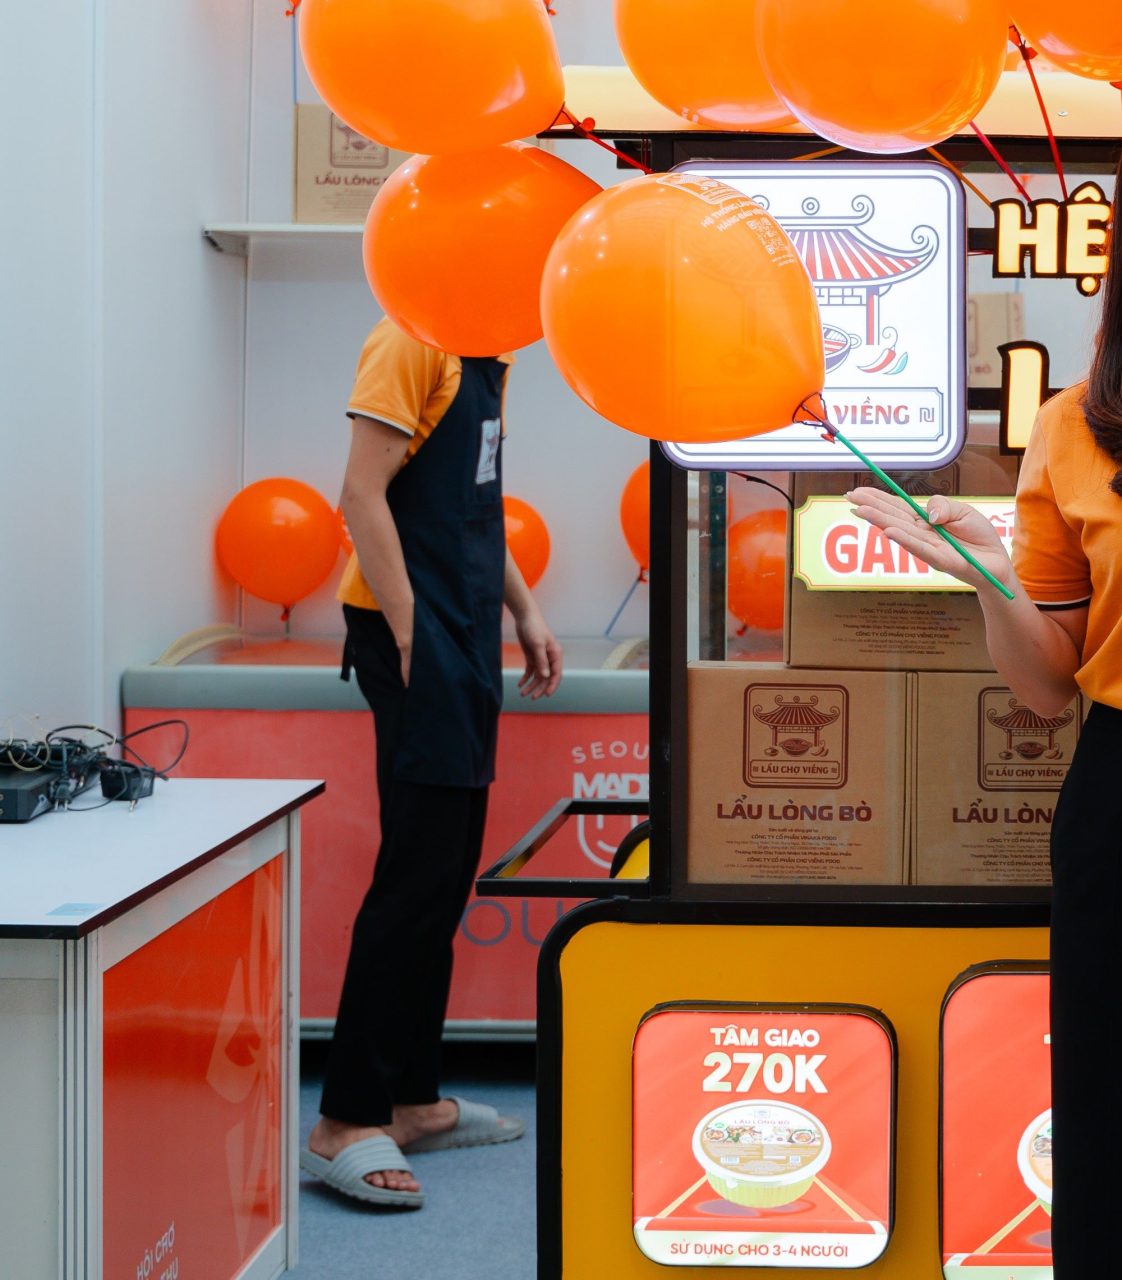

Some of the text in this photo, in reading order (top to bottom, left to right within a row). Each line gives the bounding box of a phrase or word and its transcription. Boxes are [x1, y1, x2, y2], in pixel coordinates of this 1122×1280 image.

[996, 184, 1111, 295] HỆ
[833, 396, 910, 425] VIỀNG
[571, 740, 649, 765] SEOU
[573, 772, 649, 800] MAD
[717, 794, 872, 822] LẨU LÒNG BÒ
[952, 798, 1053, 824] LẨU LÒN
[709, 1024, 820, 1048] TÂM GIAO
[702, 1052, 828, 1094] 270K
[670, 1238, 848, 1258] SỬ DỤNG CHO 3-4 NGƯỜI
